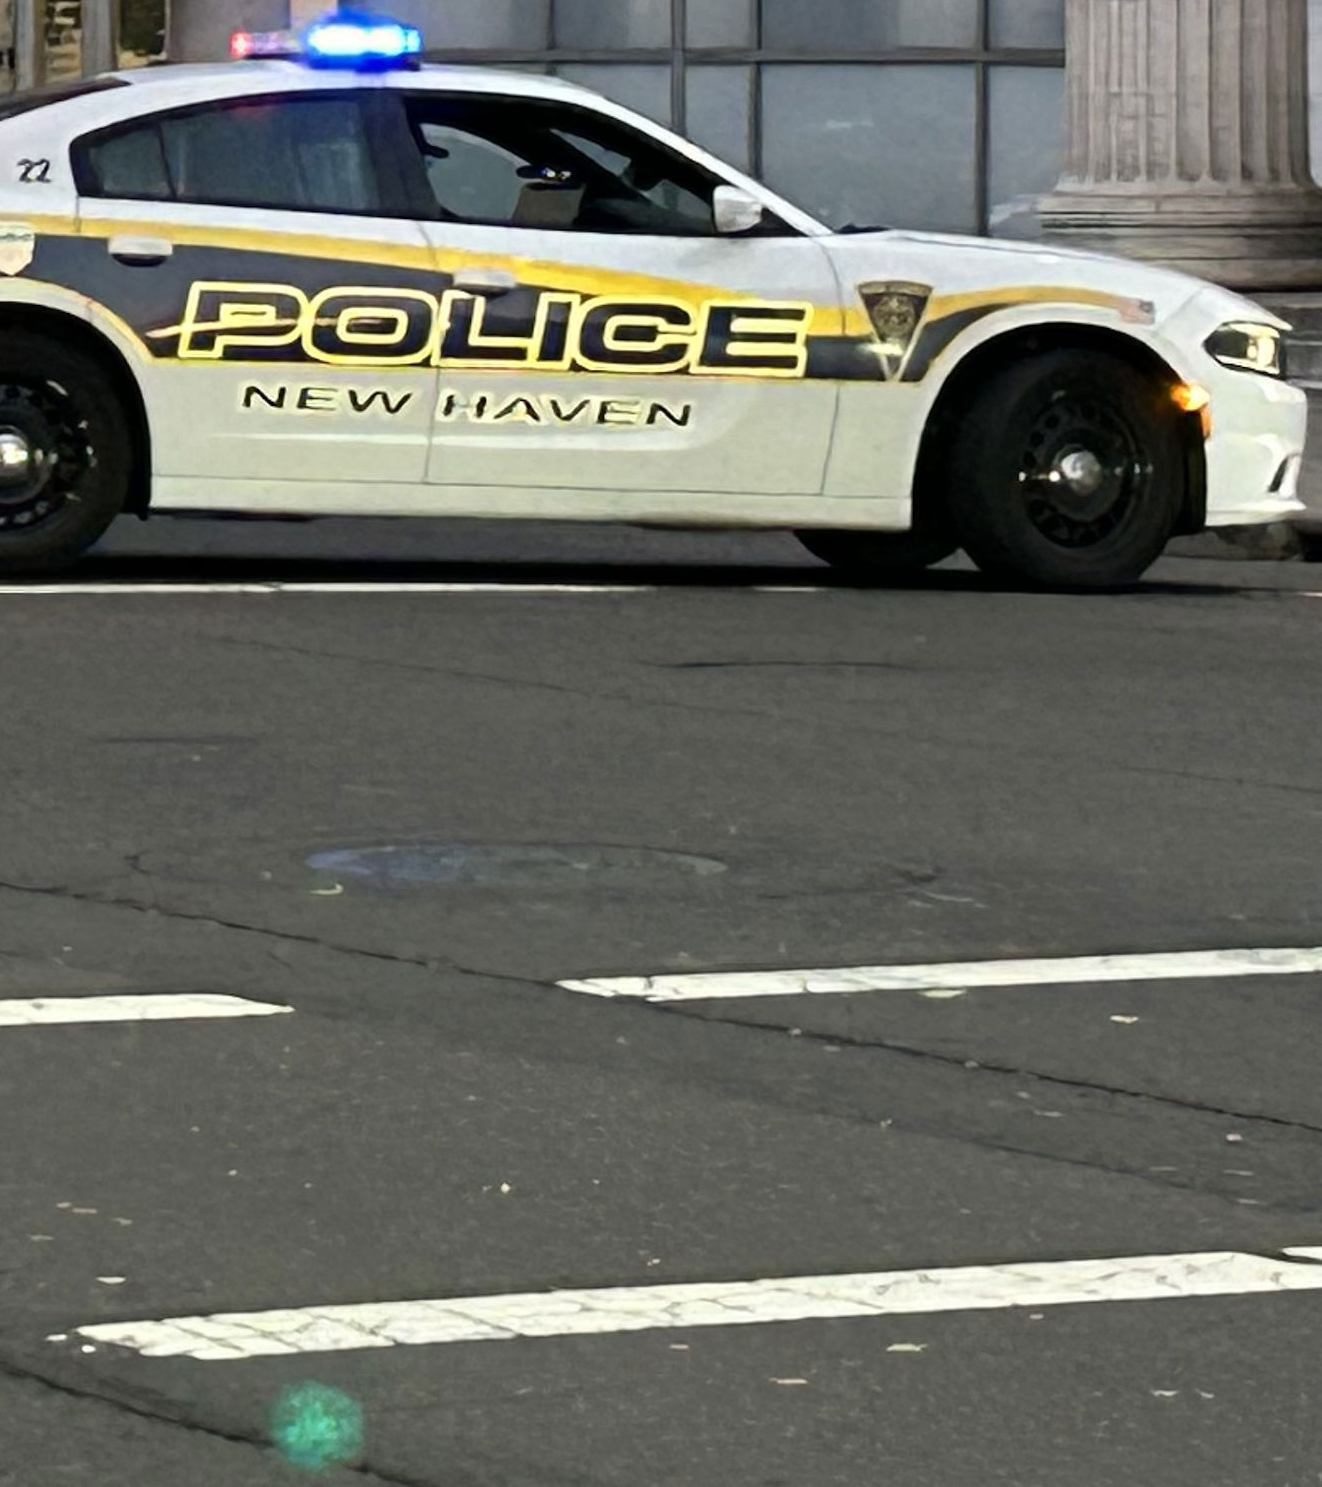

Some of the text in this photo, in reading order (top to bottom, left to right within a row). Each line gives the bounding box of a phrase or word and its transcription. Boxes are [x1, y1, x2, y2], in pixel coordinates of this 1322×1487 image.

[16, 158, 53, 184] 22
[178, 279, 811, 379] POLICE
[242, 382, 693, 429] NEW HAVEN
